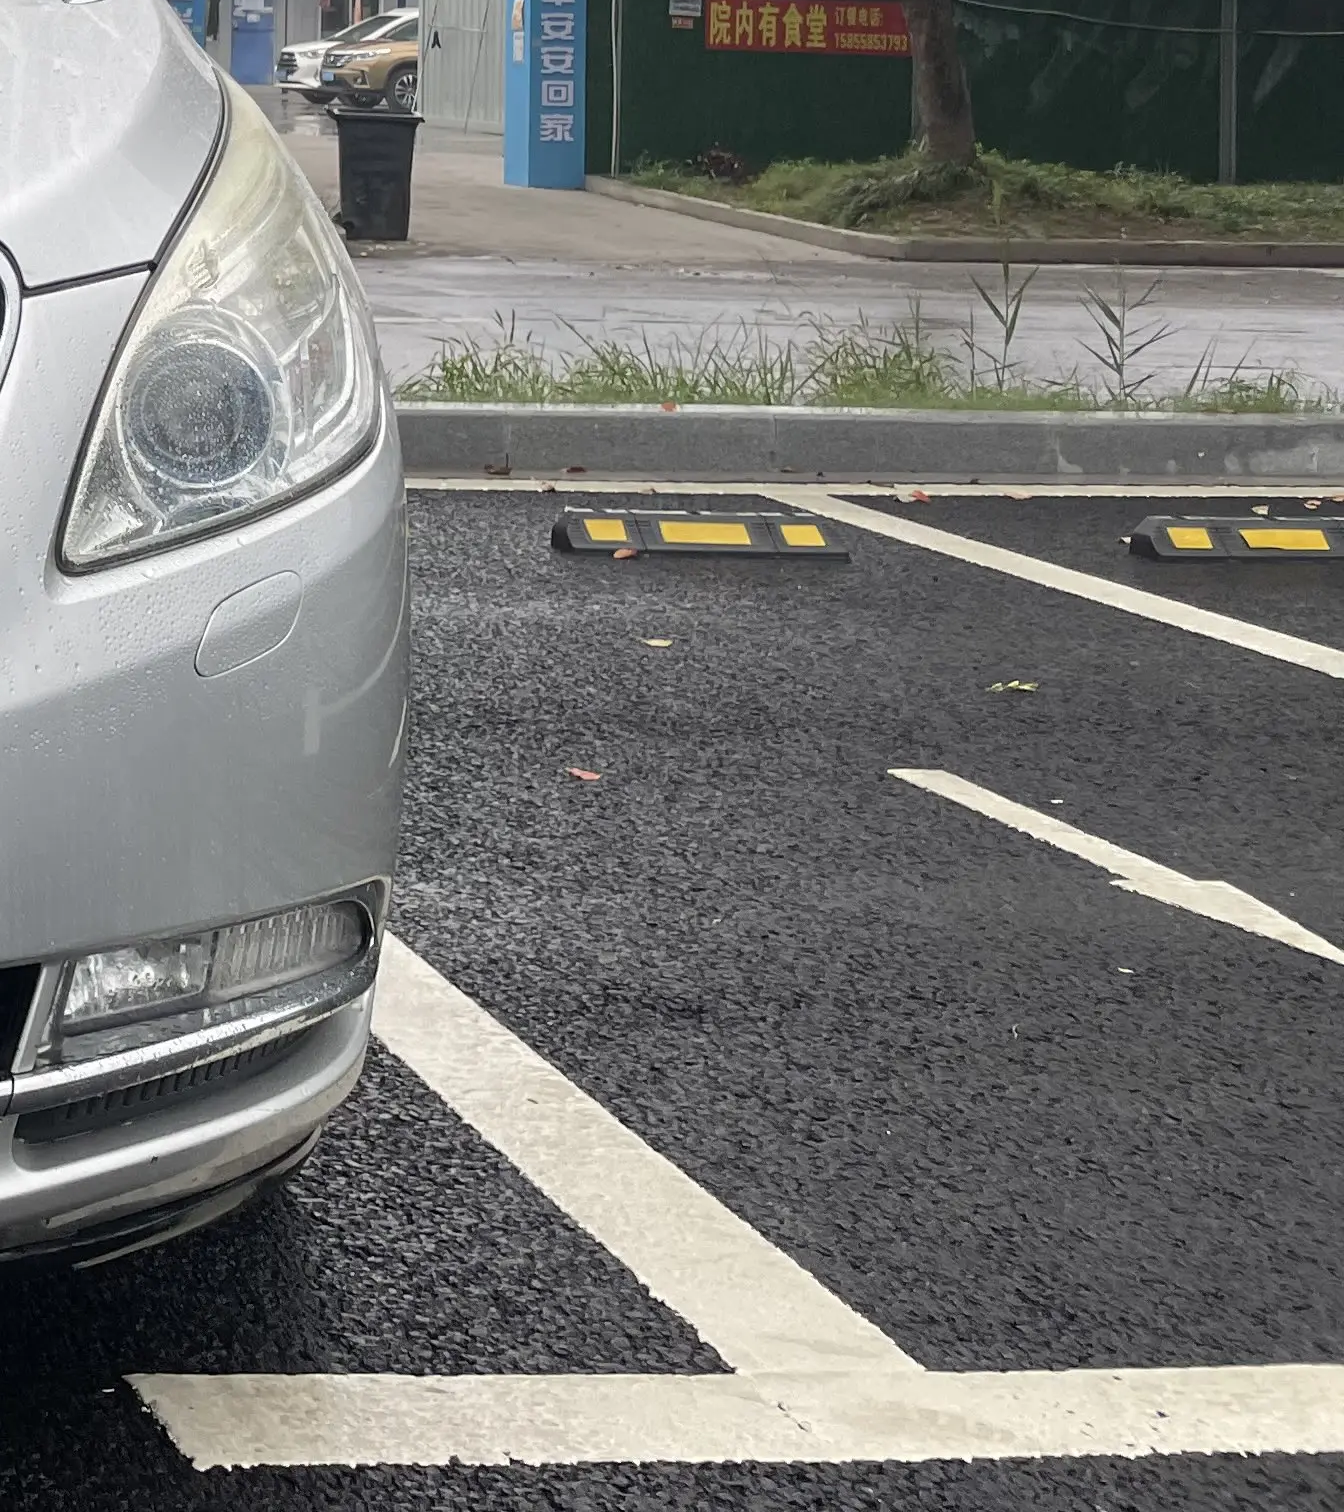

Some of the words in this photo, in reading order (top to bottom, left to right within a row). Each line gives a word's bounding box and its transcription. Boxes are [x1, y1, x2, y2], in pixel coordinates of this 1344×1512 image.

[709, 0, 827, 48] 院内有食堂
